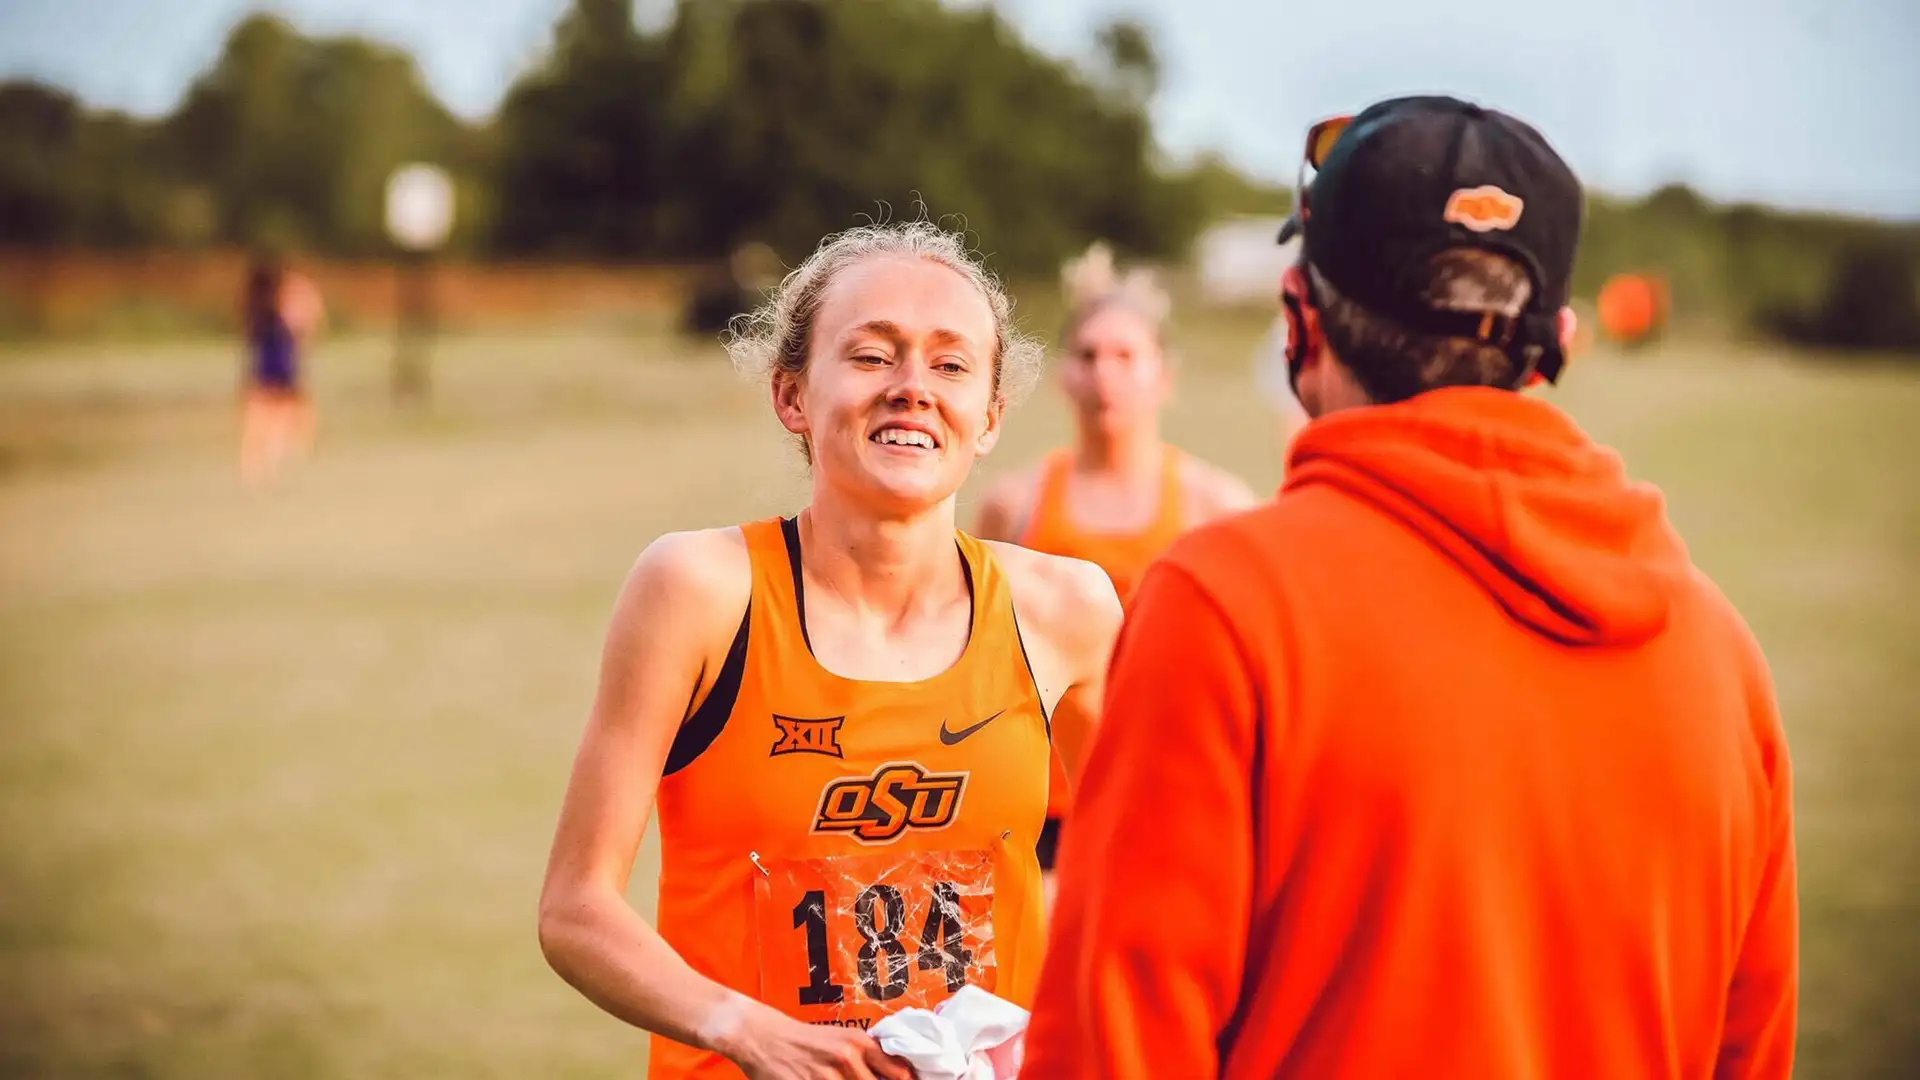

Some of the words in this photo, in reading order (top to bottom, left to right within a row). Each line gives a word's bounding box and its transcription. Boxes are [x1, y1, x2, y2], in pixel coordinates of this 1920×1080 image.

[769, 713, 845, 759] XII
[814, 765, 964, 840] OSU
[793, 881, 972, 1005] 184
